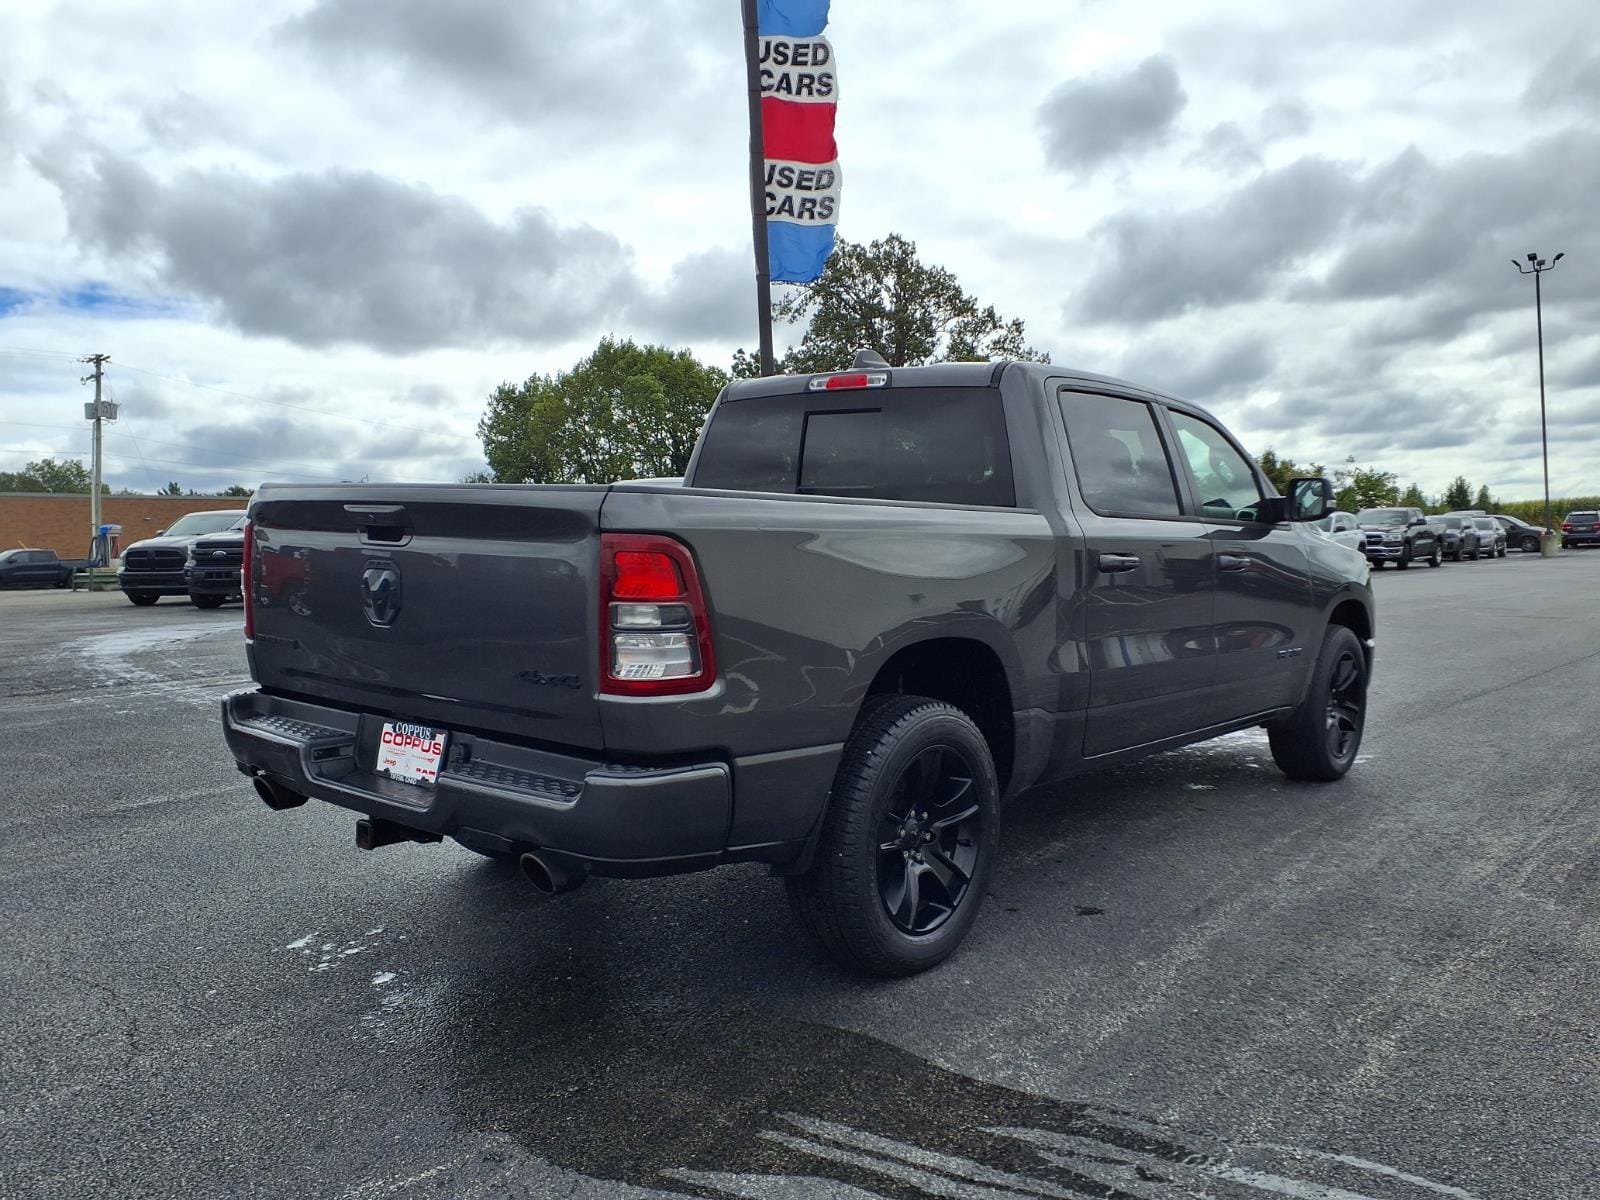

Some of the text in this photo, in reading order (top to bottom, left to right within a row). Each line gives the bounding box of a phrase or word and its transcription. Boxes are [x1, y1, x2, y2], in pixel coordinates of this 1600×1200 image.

[760, 69, 833, 96] CARS
[766, 191, 835, 220] CARS
[396, 722, 432, 740] COPPUS
[383, 732, 441, 755] COPPUS
[416, 768, 435, 776] RAM
